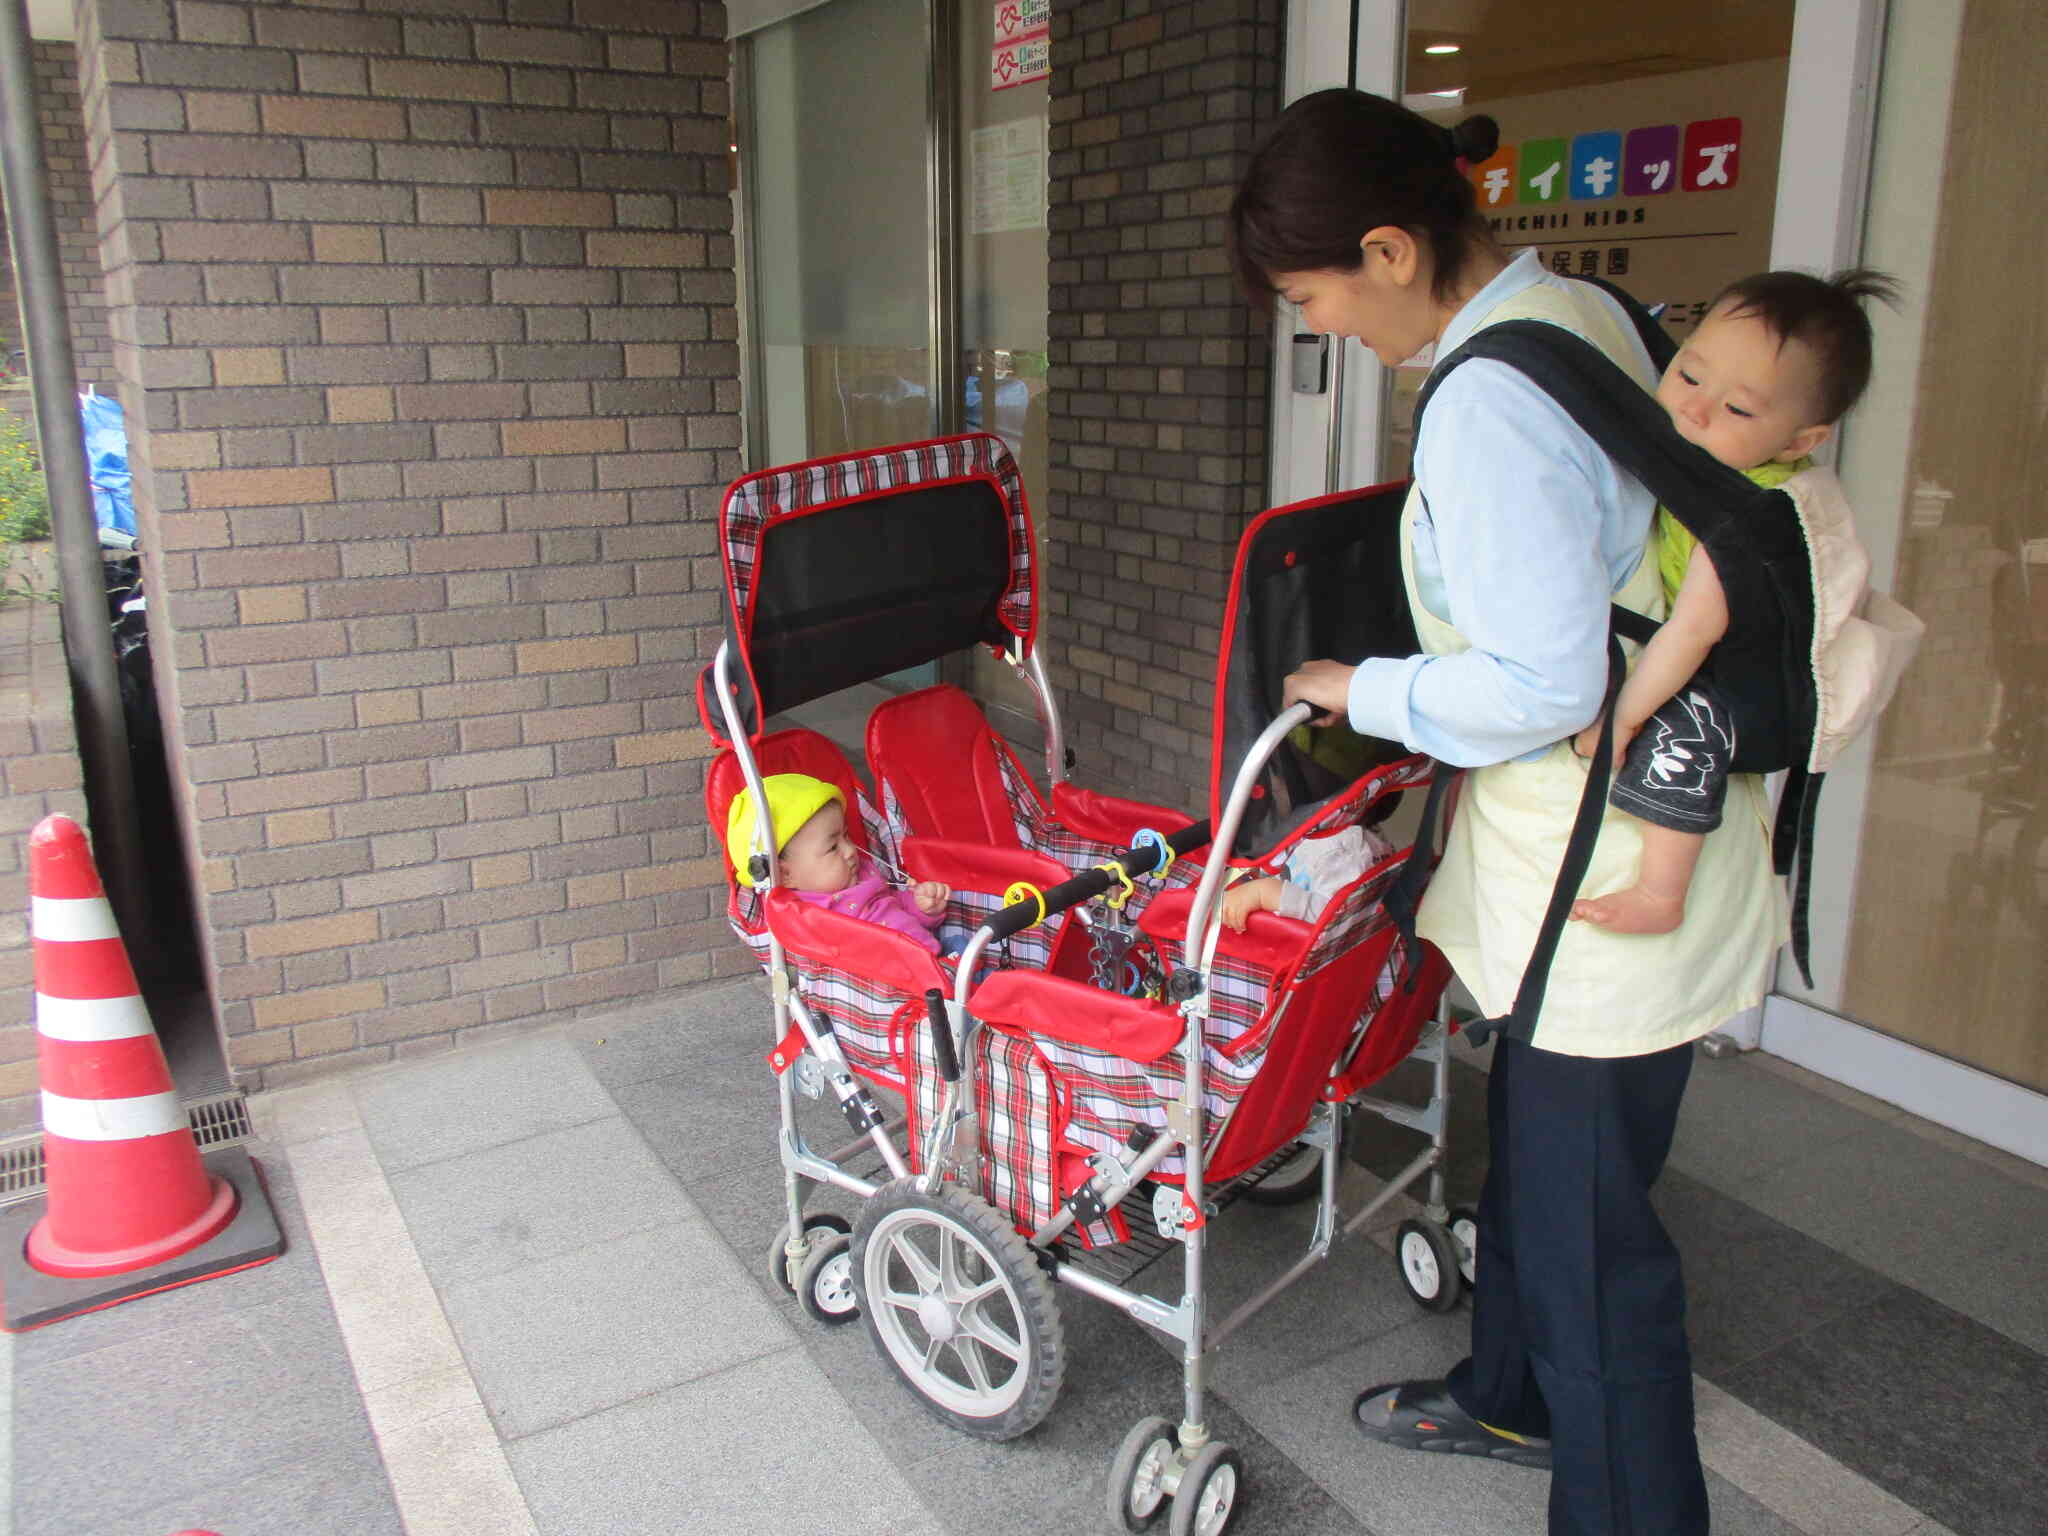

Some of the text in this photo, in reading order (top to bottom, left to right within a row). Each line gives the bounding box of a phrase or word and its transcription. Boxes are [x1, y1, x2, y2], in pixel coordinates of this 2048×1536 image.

[1483, 143, 1737, 204] チイキッズ
[1584, 208, 1646, 227] KIDS
